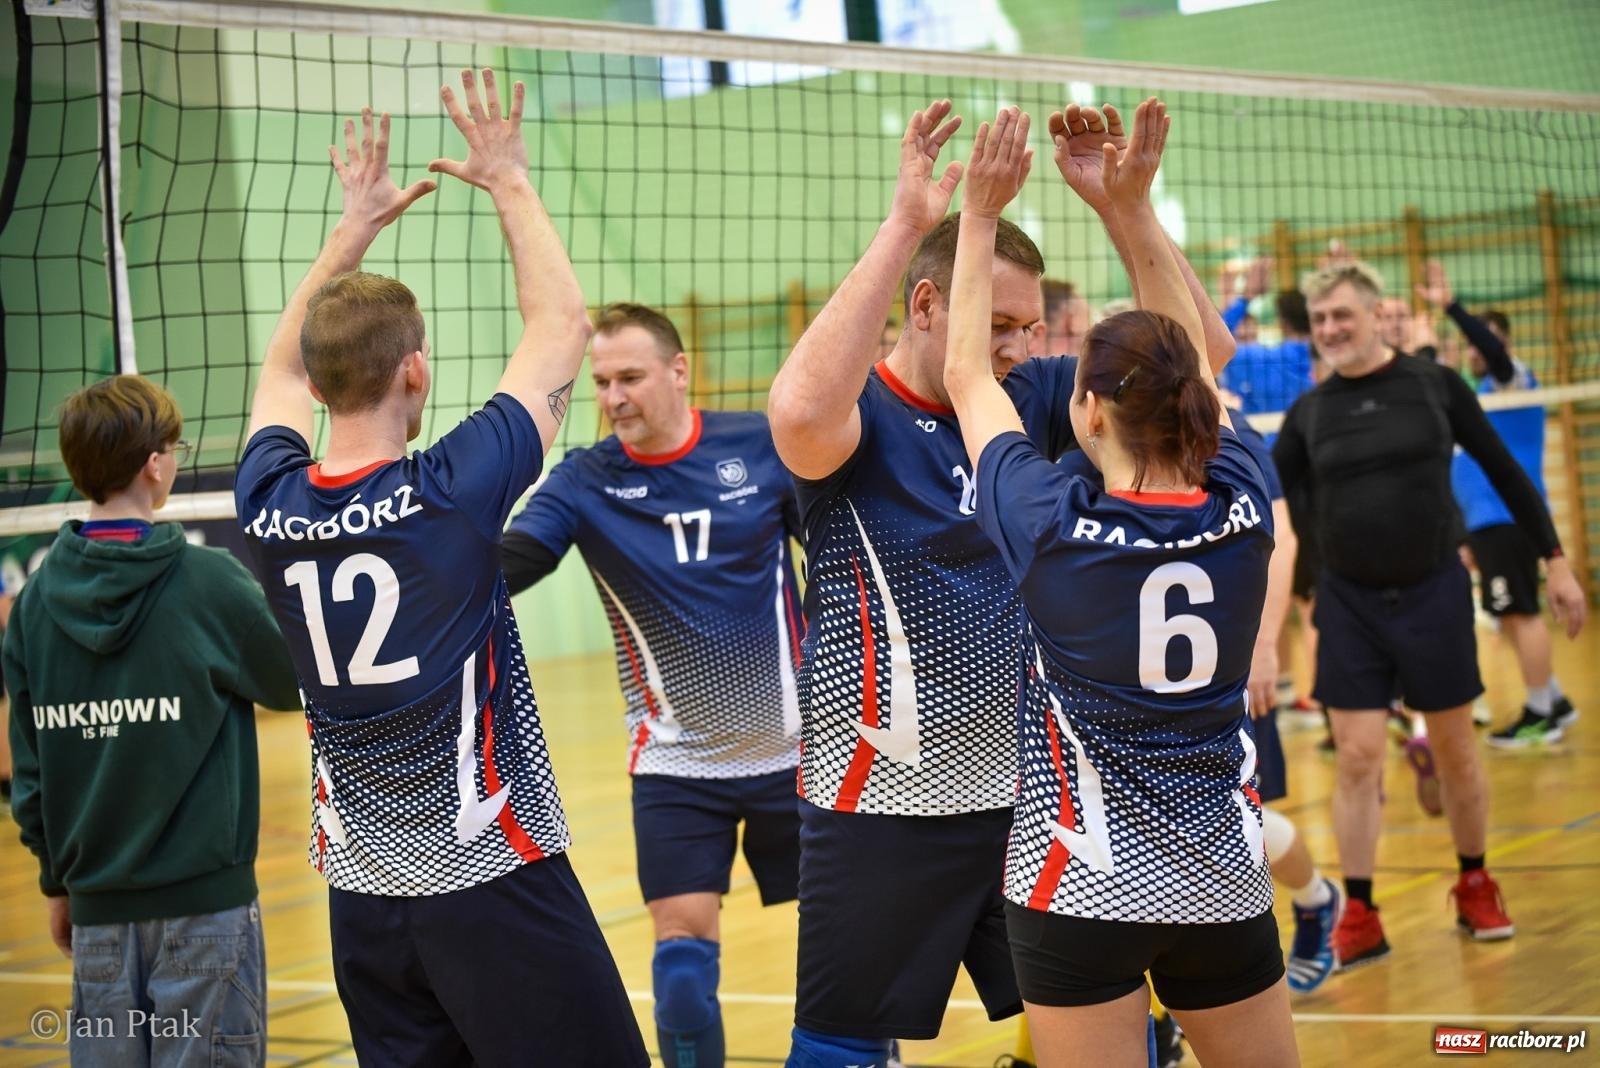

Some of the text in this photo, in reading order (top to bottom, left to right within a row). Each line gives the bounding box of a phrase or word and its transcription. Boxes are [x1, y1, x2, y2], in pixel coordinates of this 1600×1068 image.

[662, 508, 712, 564] 17
[283, 552, 421, 687] 12
[1138, 561, 1219, 694] 6
[32, 696, 181, 730] UNKNOWN
[82, 726, 96, 740] IS
